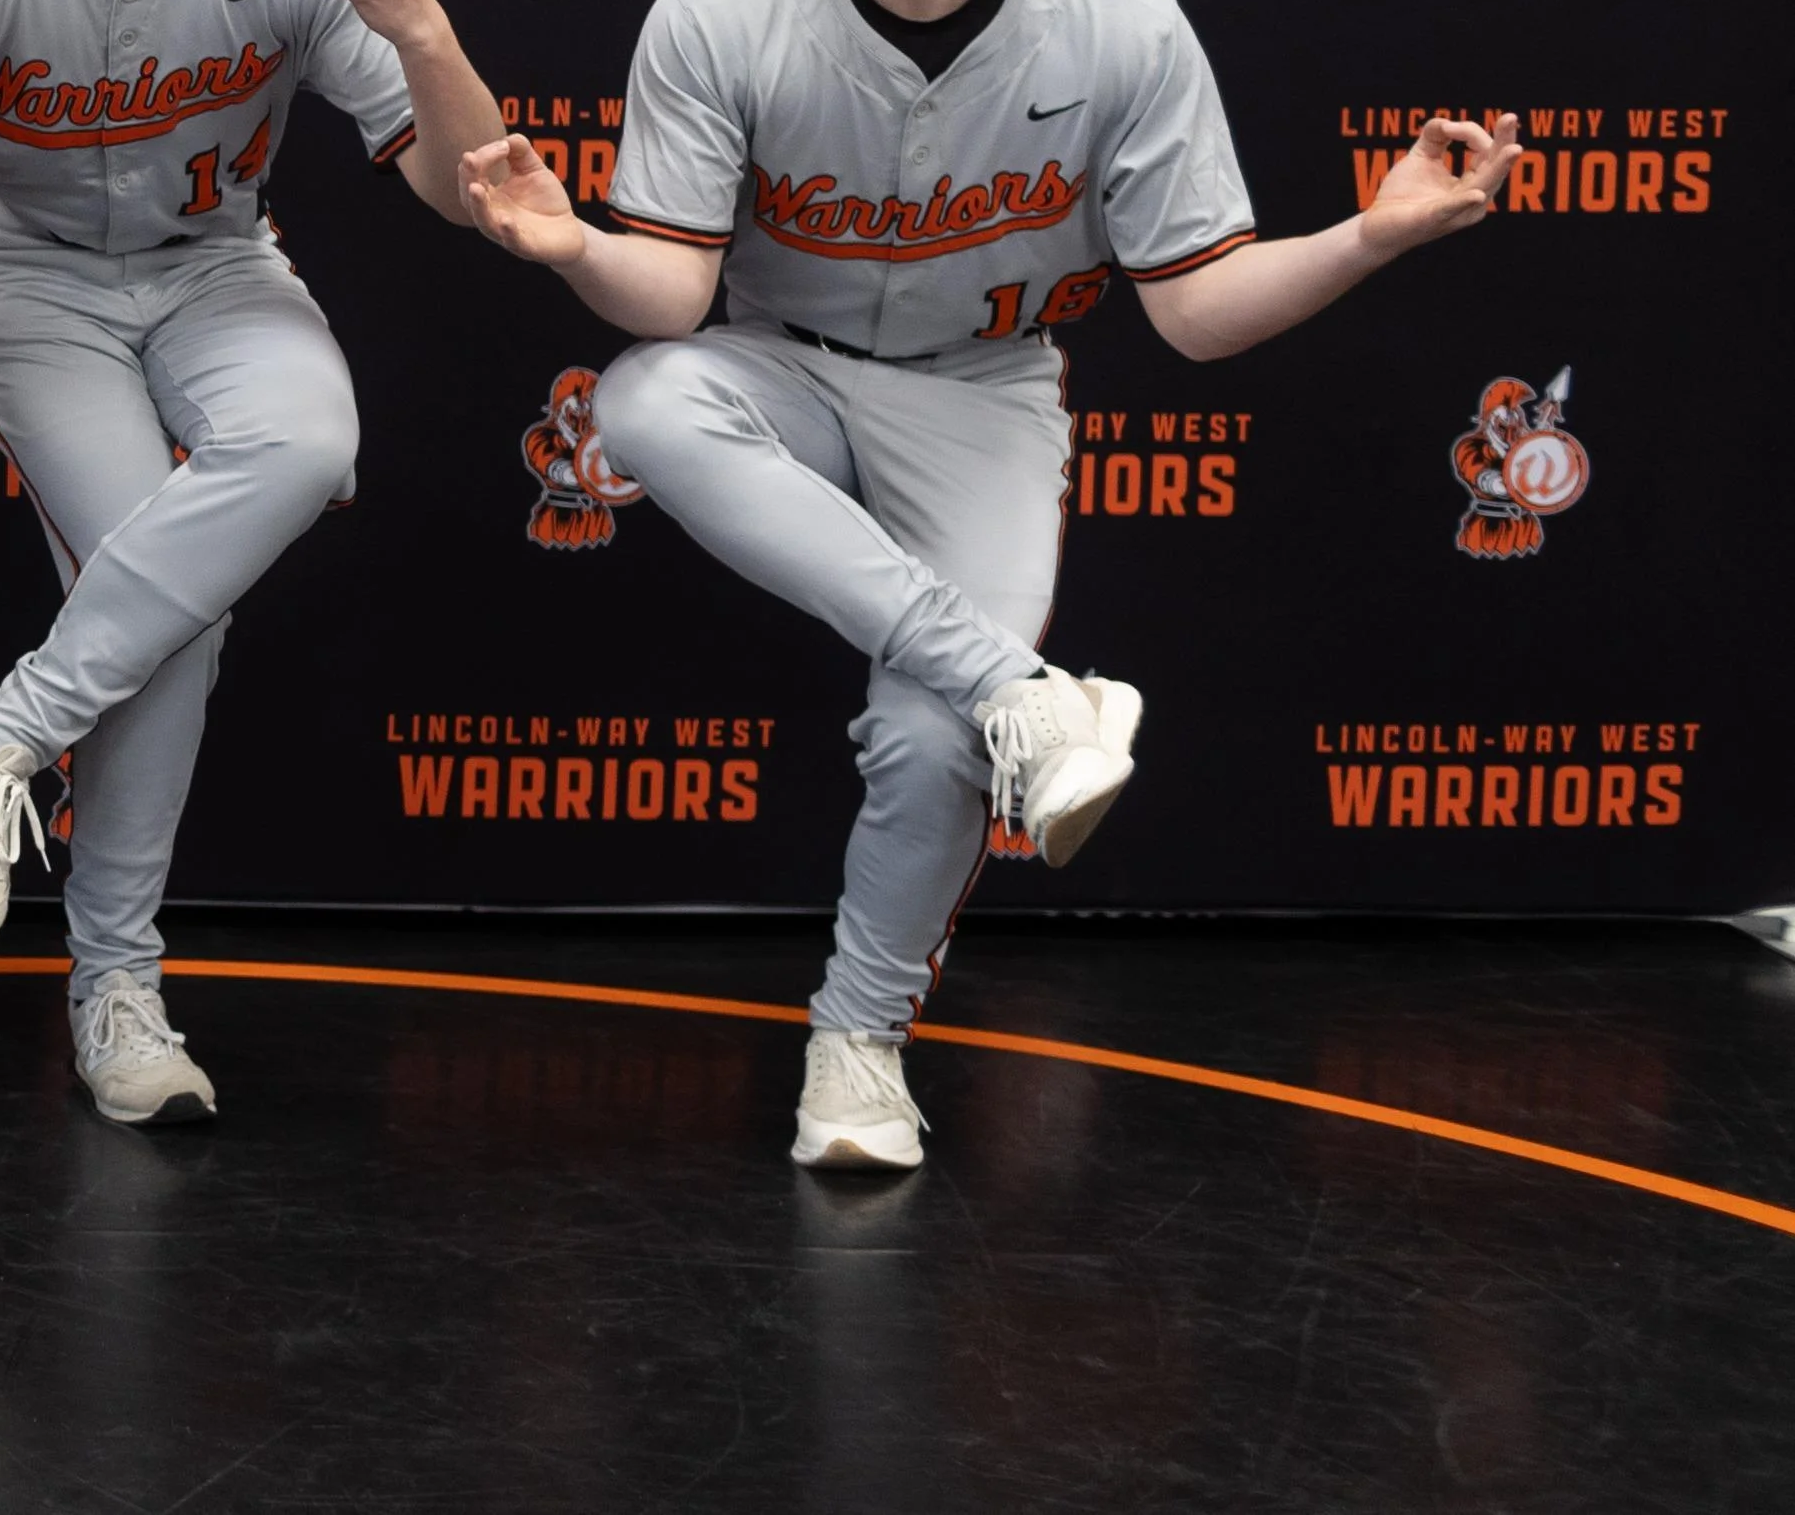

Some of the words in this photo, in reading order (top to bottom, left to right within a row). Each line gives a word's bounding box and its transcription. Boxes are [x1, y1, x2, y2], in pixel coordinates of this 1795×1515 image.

[1628, 109, 1728, 138] WEST
[752, 160, 1084, 244] Warriors
[1152, 413, 1251, 442] WEST
[388, 714, 649, 745] LINCOLN-WAY
[675, 719, 774, 747] WEST
[1316, 725, 1575, 753] LINCOLN-WAY
[1601, 723, 1699, 752] WEST
[400, 755, 758, 821] WARRIORS
[1328, 764, 1682, 827] WARRIORS
